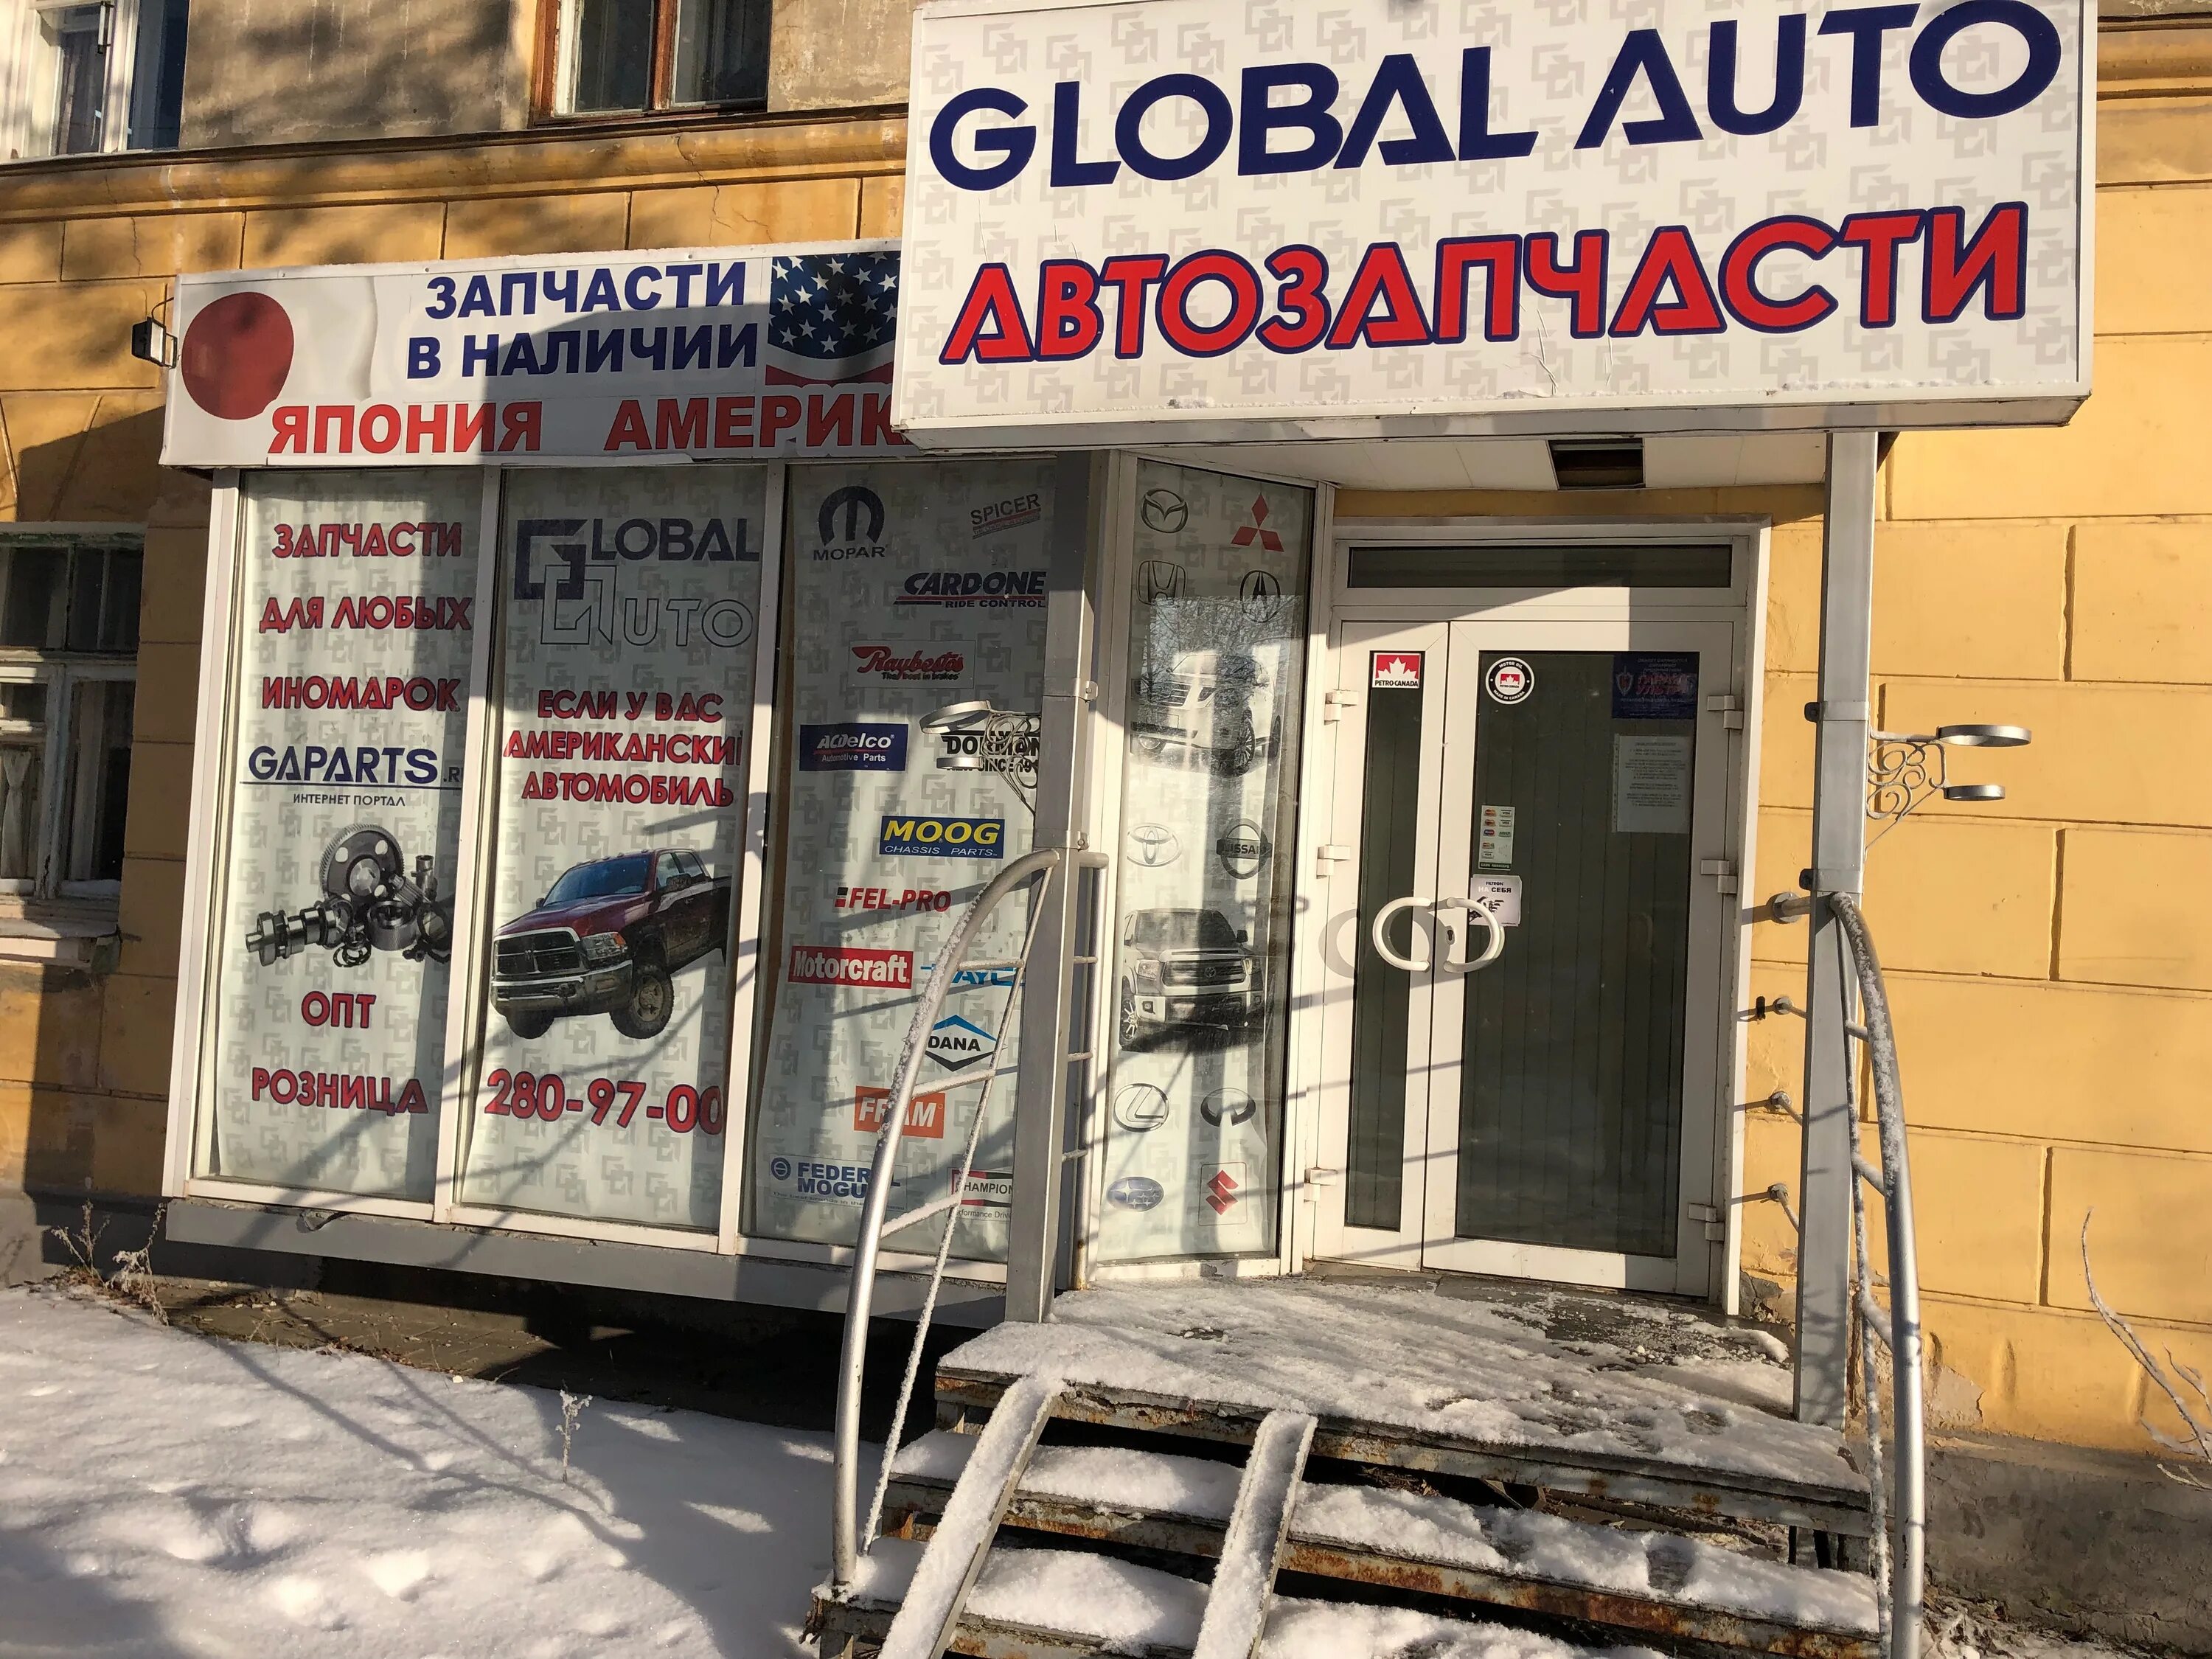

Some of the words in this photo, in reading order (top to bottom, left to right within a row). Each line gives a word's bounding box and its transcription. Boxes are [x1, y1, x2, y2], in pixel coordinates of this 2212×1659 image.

[929, 46, 1538, 190] GLOBAL
[1574, 0, 2062, 149] AUTO
[425, 261, 746, 319] ЗАПЧАСТИ
[939, 201, 2028, 365] АВТОЗАПЧАСТИ
[407, 336, 442, 379] В
[461, 323, 758, 378] НАЛИЧИИ
[268, 400, 543, 454] ЯПОНИЯ
[604, 392, 913, 451] АМЕРИК
[970, 493, 1040, 525] SPICER
[272, 522, 462, 558] ЗАПЧАСТИ
[813, 546, 886, 561] MOPAR
[904, 571, 1047, 595] CARDONE
[259, 596, 324, 633] ДЛЯ
[331, 596, 473, 630] ЛЮБЫХ
[945, 600, 975, 608] RIDE
[979, 600, 1046, 608] CONTROL
[852, 646, 964, 680] Raybestos
[262, 676, 461, 712] ИНОМАРОК
[538, 690, 618, 719] ЕСЛИ
[625, 692, 648, 720] У
[655, 692, 724, 723] ВАС
[1509, 691, 1526, 700] CANADA
[504, 730, 742, 766] АМЕРИКАНСКИ
[816, 733, 891, 748] ACDelco
[821, 753, 858, 762] Automotive
[863, 753, 886, 762] Parts
[294, 793, 350, 805] ИНТЕРНЕТ
[354, 795, 406, 807] ПОРТАЛ
[521, 771, 734, 807] АВТОМОБИЛЬ
[883, 820, 1001, 844] MOOG
[884, 845, 941, 855] CHASSIS
[950, 848, 994, 857] PARTS
[849, 887, 952, 912] FEL-PRO
[793, 950, 908, 983] Motorcraft
[301, 991, 377, 1028] ОПТ
[928, 1035, 981, 1051] DANA
[252, 1067, 429, 1116] РОЗНИЦА
[484, 1068, 723, 1135] 280-97-00
[797, 1162, 901, 1187] FEDERL
[797, 1178, 866, 1199] MOGU
